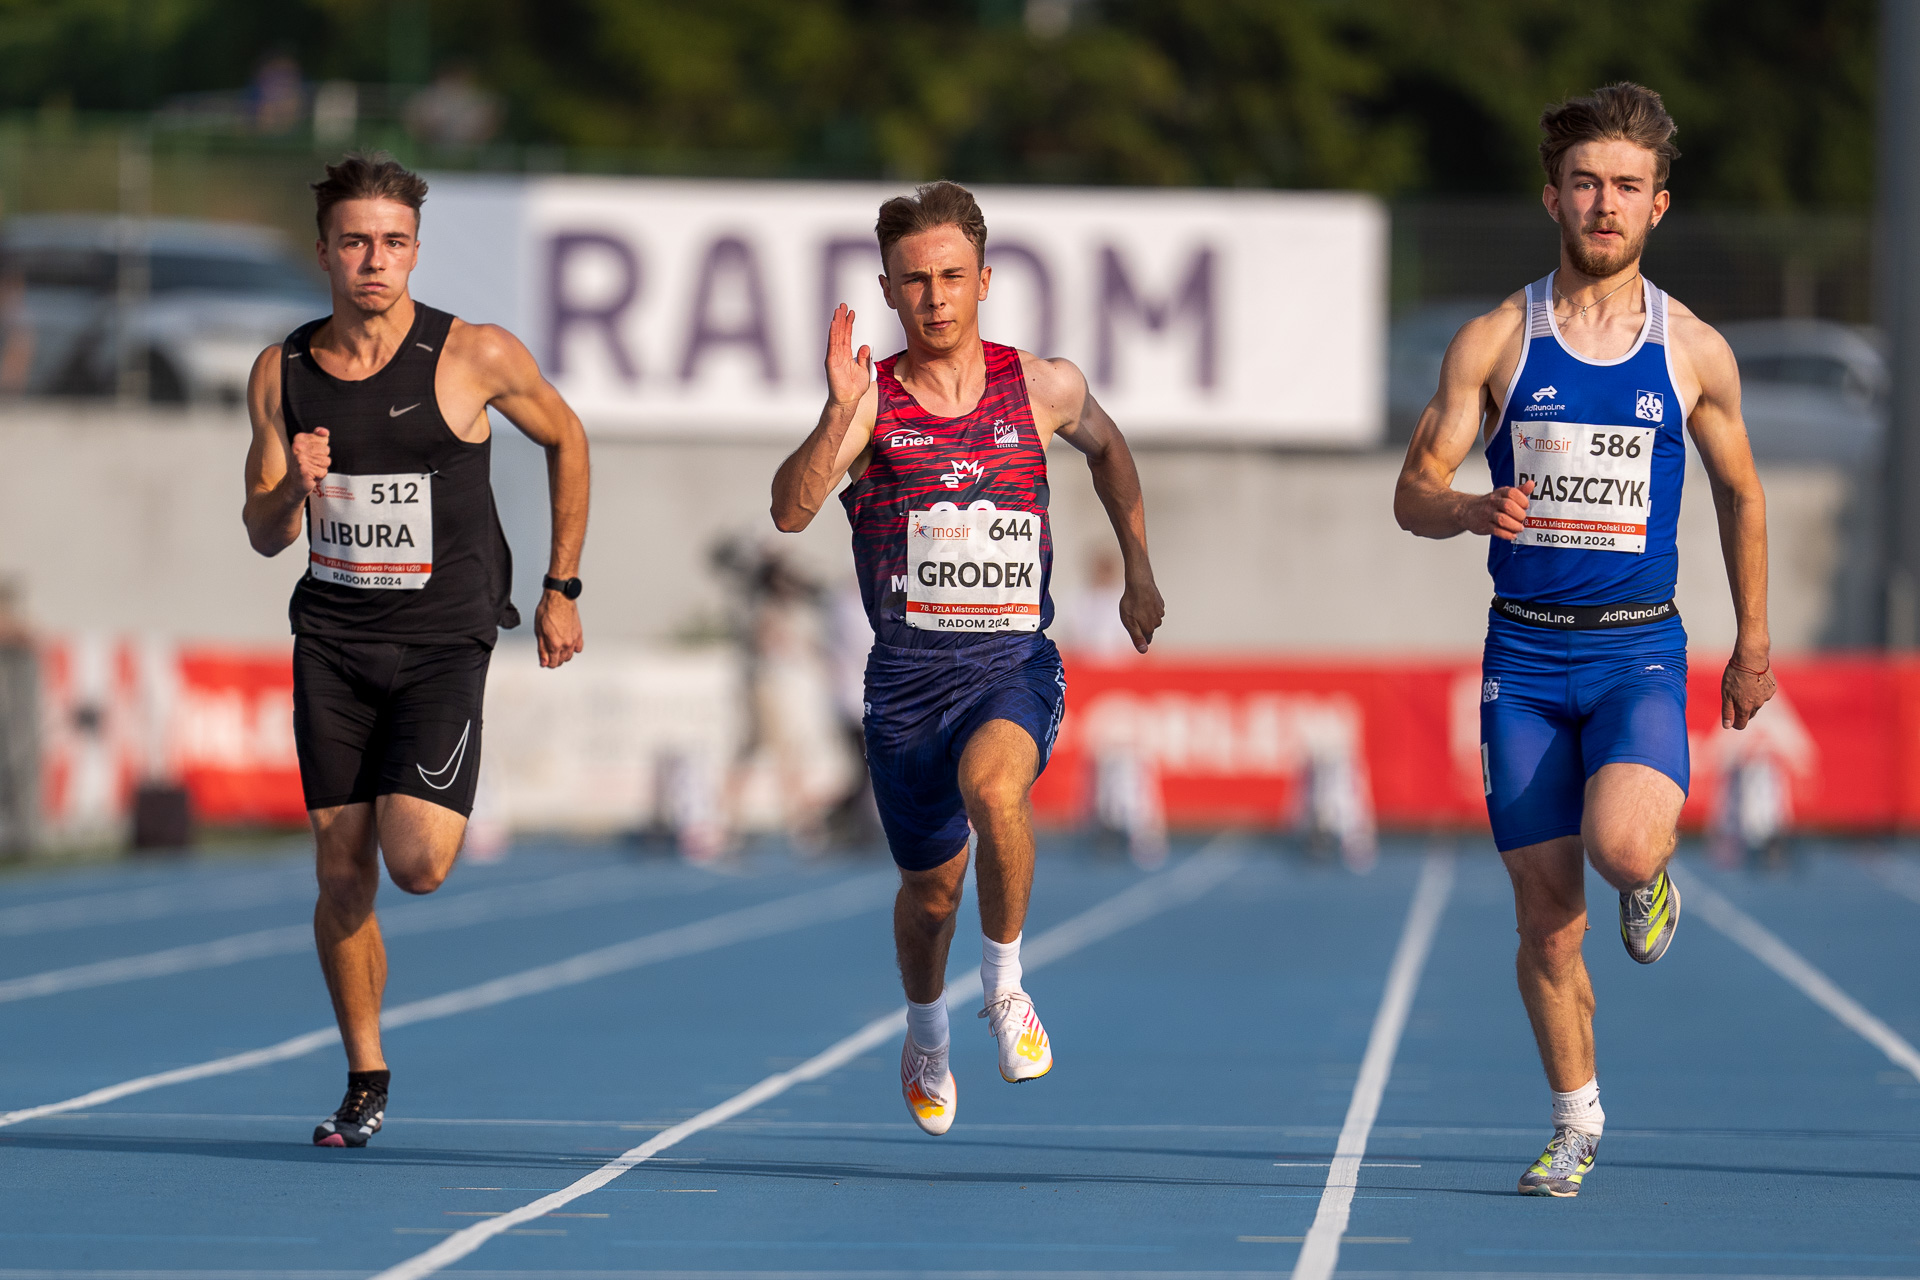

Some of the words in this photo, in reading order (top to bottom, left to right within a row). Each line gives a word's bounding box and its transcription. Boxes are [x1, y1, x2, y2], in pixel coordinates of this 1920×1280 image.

[891, 435, 934, 448] Enea
[1535, 436, 1572, 451] mosir
[1589, 433, 1641, 459] 586
[370, 482, 419, 504] 512
[320, 518, 415, 548] LIBURA
[932, 524, 971, 538] mosir
[988, 518, 1033, 541] 644
[1531, 519, 1548, 527] PZLA
[1549, 520, 1596, 531] Mistrzostwa
[1597, 523, 1620, 532] Polski
[1621, 525, 1636, 533] U20
[1536, 532, 1581, 545] RADOM
[1584, 535, 1616, 547] 2024
[342, 561, 383, 572] Mistrzostwa
[333, 571, 370, 585] RADOM
[373, 576, 401, 586] 2024
[917, 561, 1034, 588] GRODEK
[920, 604, 931, 612] 78.
[951, 606, 998, 614] Mistrzostwa
[1503, 601, 1575, 624] AdRunaLine
[1599, 602, 1670, 623] AdRunaLine
[938, 618, 985, 629] RADOM
